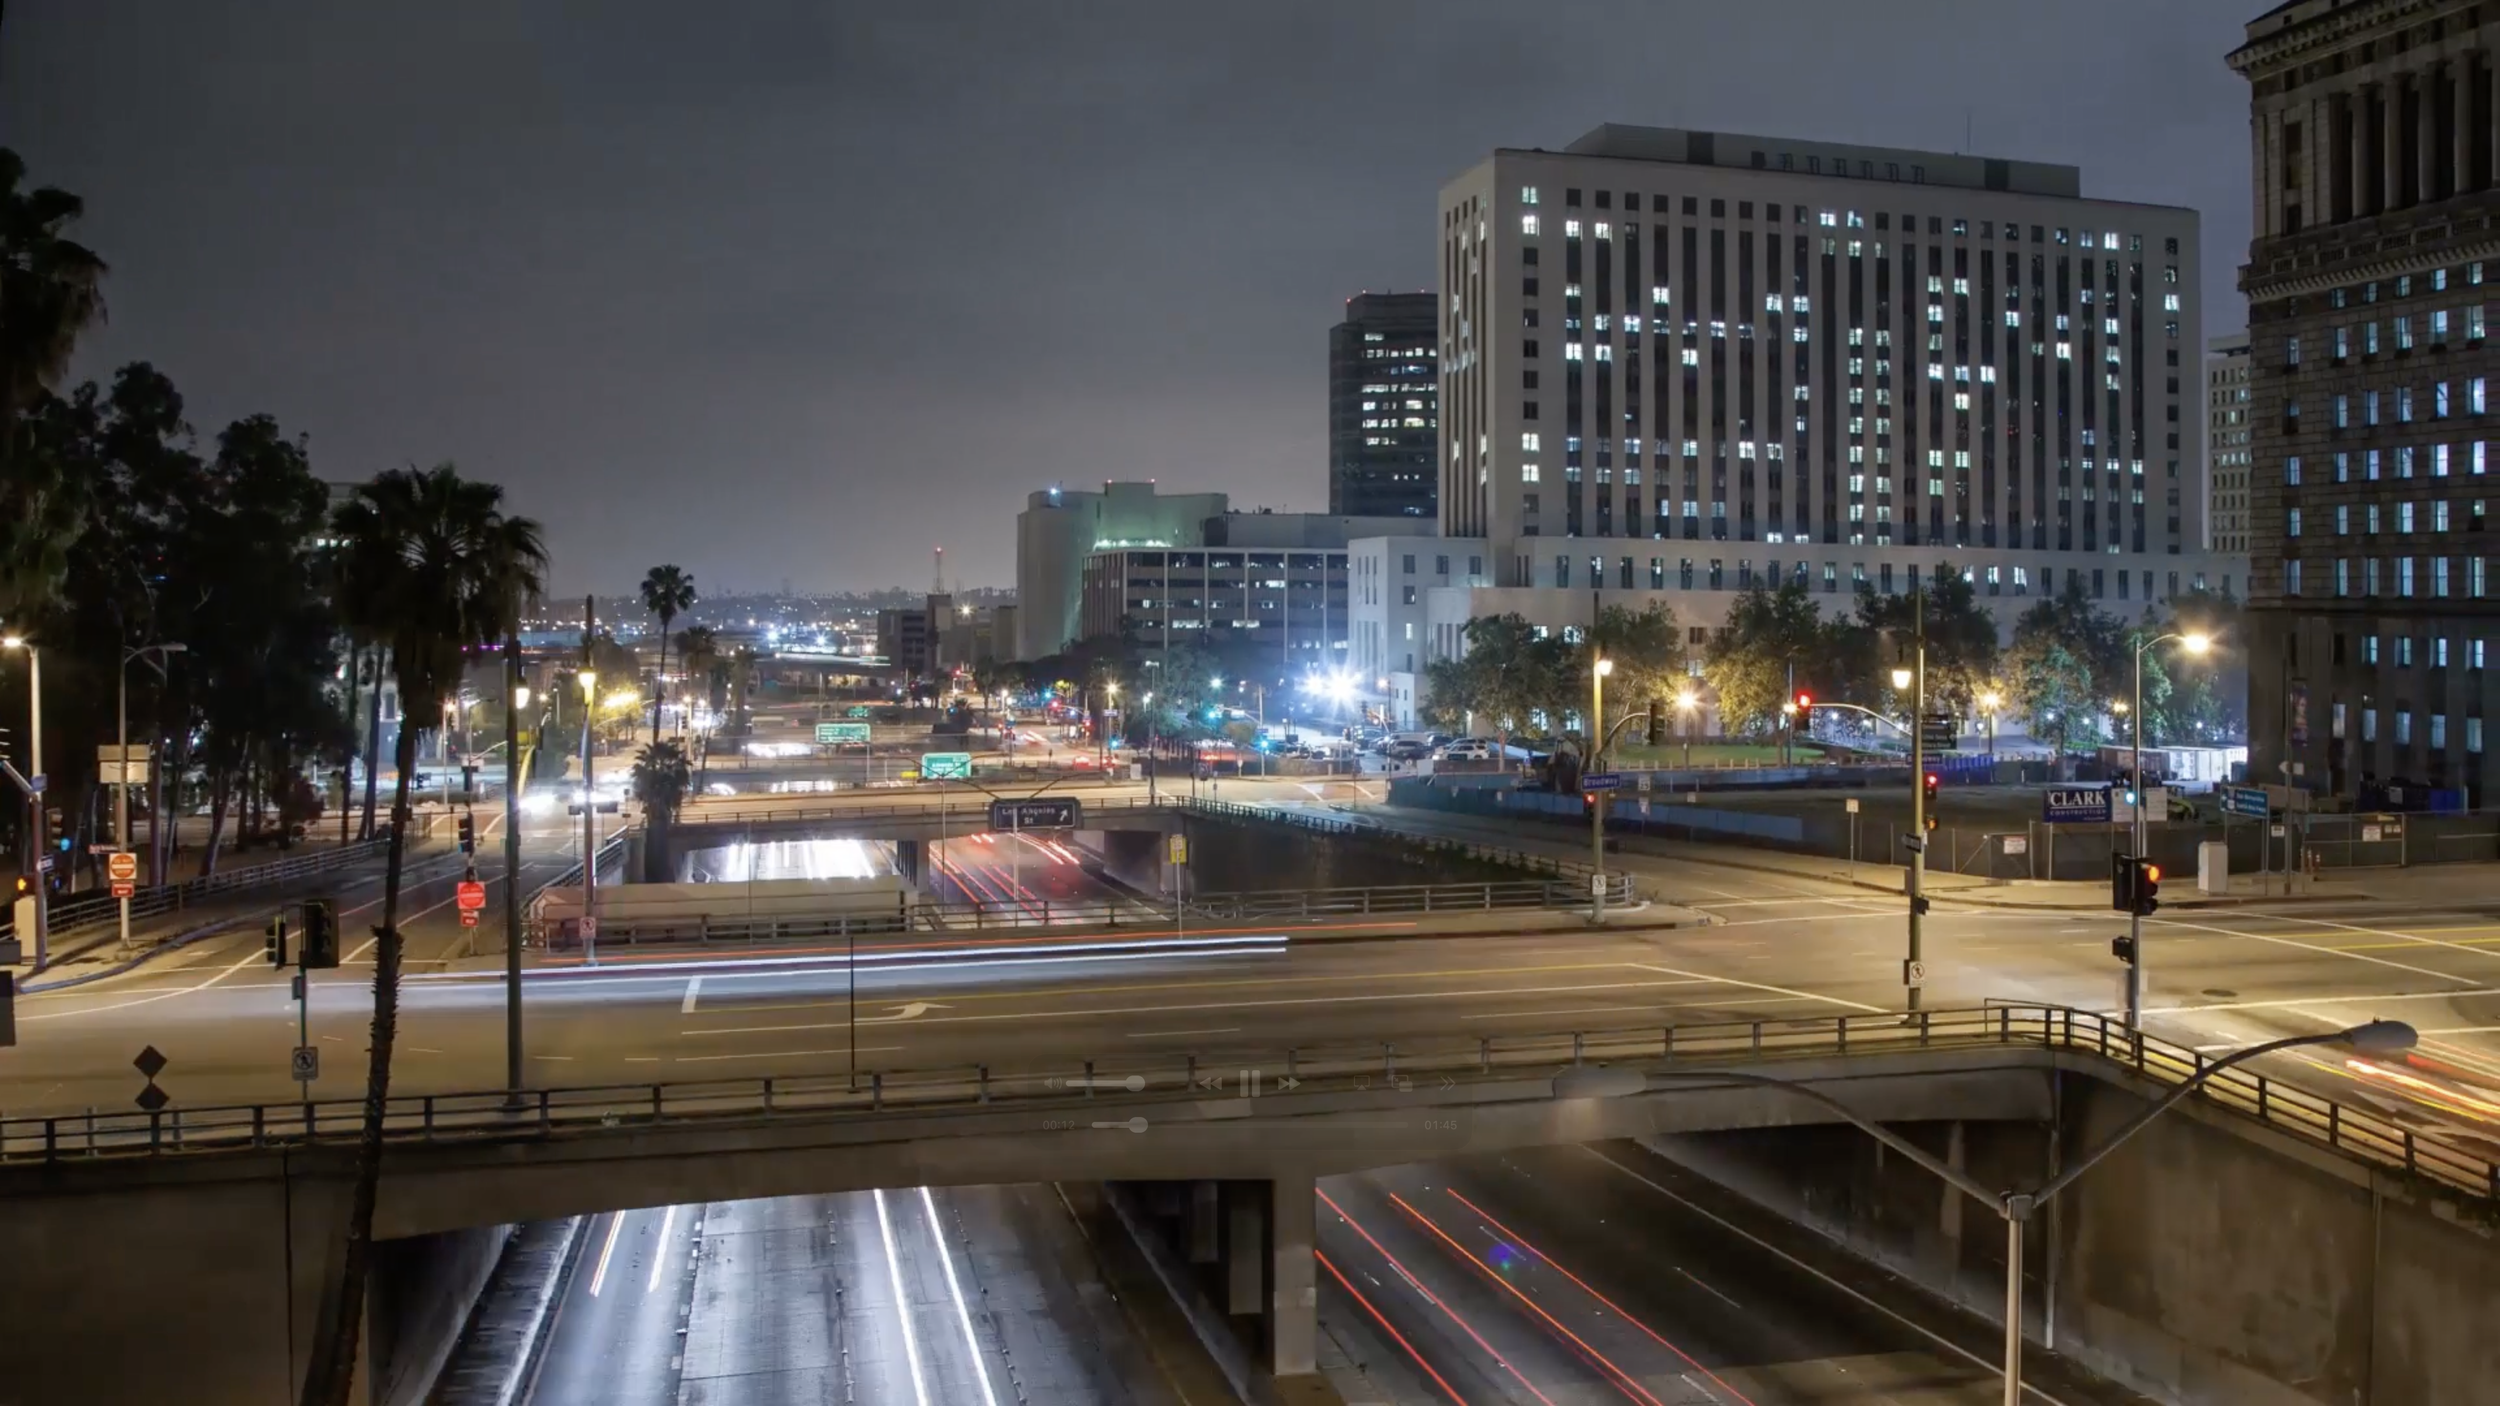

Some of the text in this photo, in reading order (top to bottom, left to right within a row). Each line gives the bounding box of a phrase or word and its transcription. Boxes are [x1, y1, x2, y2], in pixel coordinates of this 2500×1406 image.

[1583, 778, 1617, 787] Broadway
[2050, 791, 2106, 806] CLARK
[1022, 808, 1055, 816] Angeles
